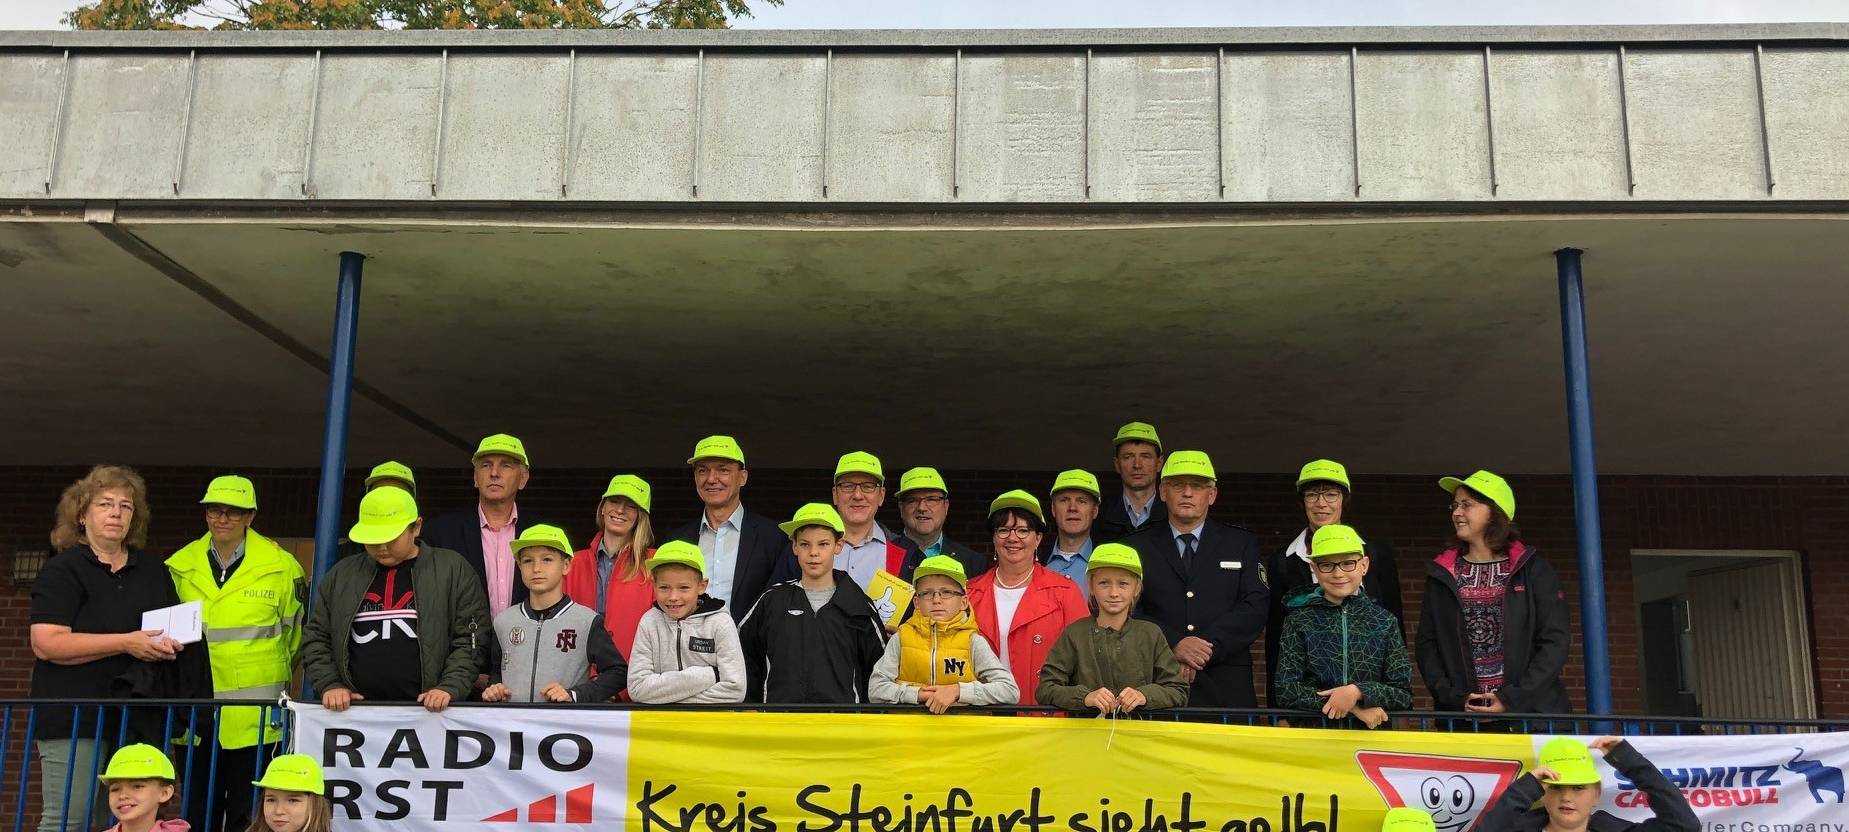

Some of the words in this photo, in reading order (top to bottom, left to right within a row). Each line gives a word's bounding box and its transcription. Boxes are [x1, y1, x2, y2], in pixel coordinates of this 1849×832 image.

[243, 589, 275, 600] POLIZEI
[943, 658, 966, 677] NY
[322, 727, 594, 773] RADIO
[1613, 765, 1782, 791] SHMITZ
[323, 779, 464, 822] RST
[636, 780, 777, 832] Kreis
[795, 783, 1056, 832] Steinfurt
[1614, 787, 1779, 809] CAOBULL
